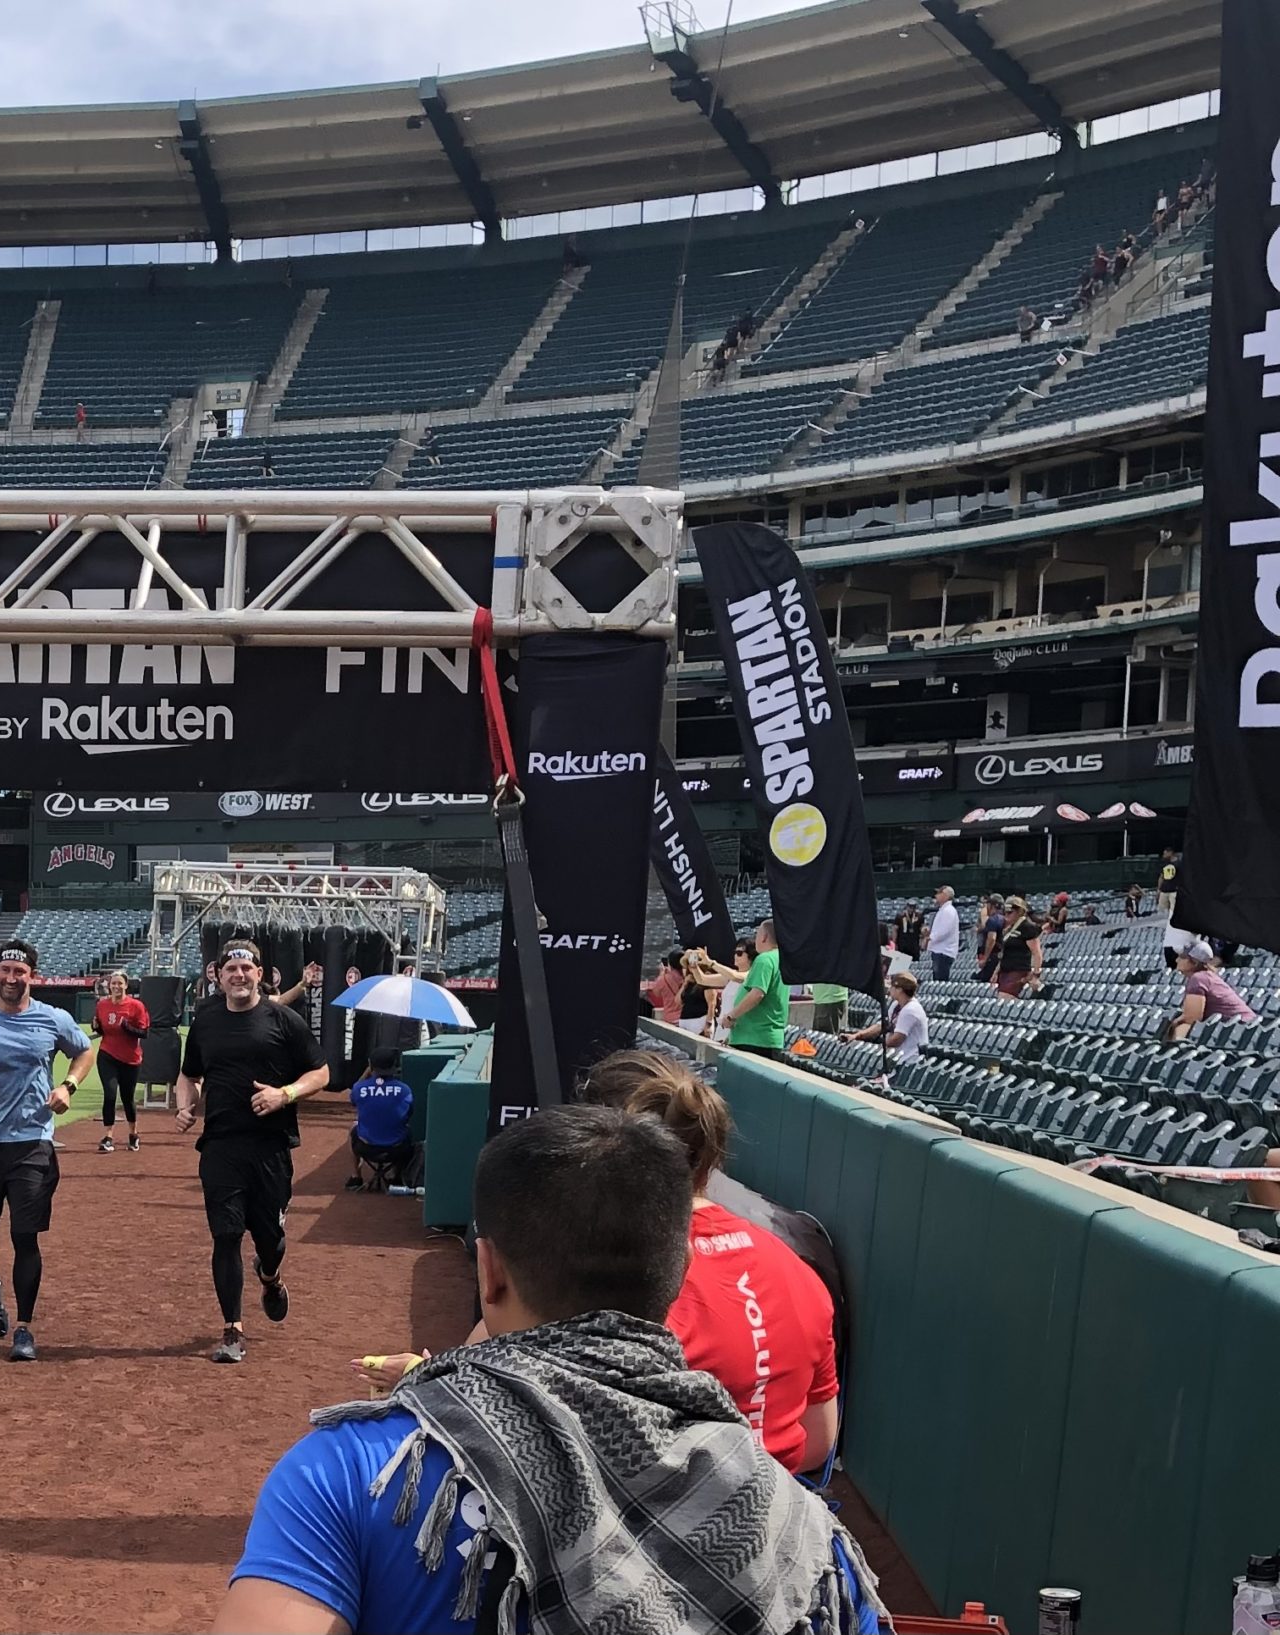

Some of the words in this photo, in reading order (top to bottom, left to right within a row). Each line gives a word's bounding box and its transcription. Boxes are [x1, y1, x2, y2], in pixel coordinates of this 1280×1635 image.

[778, 578, 831, 725] STADION
[1036, 642, 1068, 655] CLUB
[325, 646, 519, 693] FIN
[836, 664, 870, 676] CLUB
[727, 590, 815, 804] SPARTAN
[42, 695, 234, 740] Rakuten
[528, 750, 646, 774] Rakuten
[1154, 739, 1194, 766] AMB
[898, 767, 935, 780] CRAFT
[1009, 754, 1104, 777] LEXUS
[78, 796, 170, 812] LEXUS
[228, 794, 253, 806] FOX
[265, 793, 312, 811] WEST
[47, 843, 115, 872] ANGELS
[663, 831, 713, 928] FINISH
[513, 934, 607, 950] RAFT
[360, 1086, 402, 1098] STAFF
